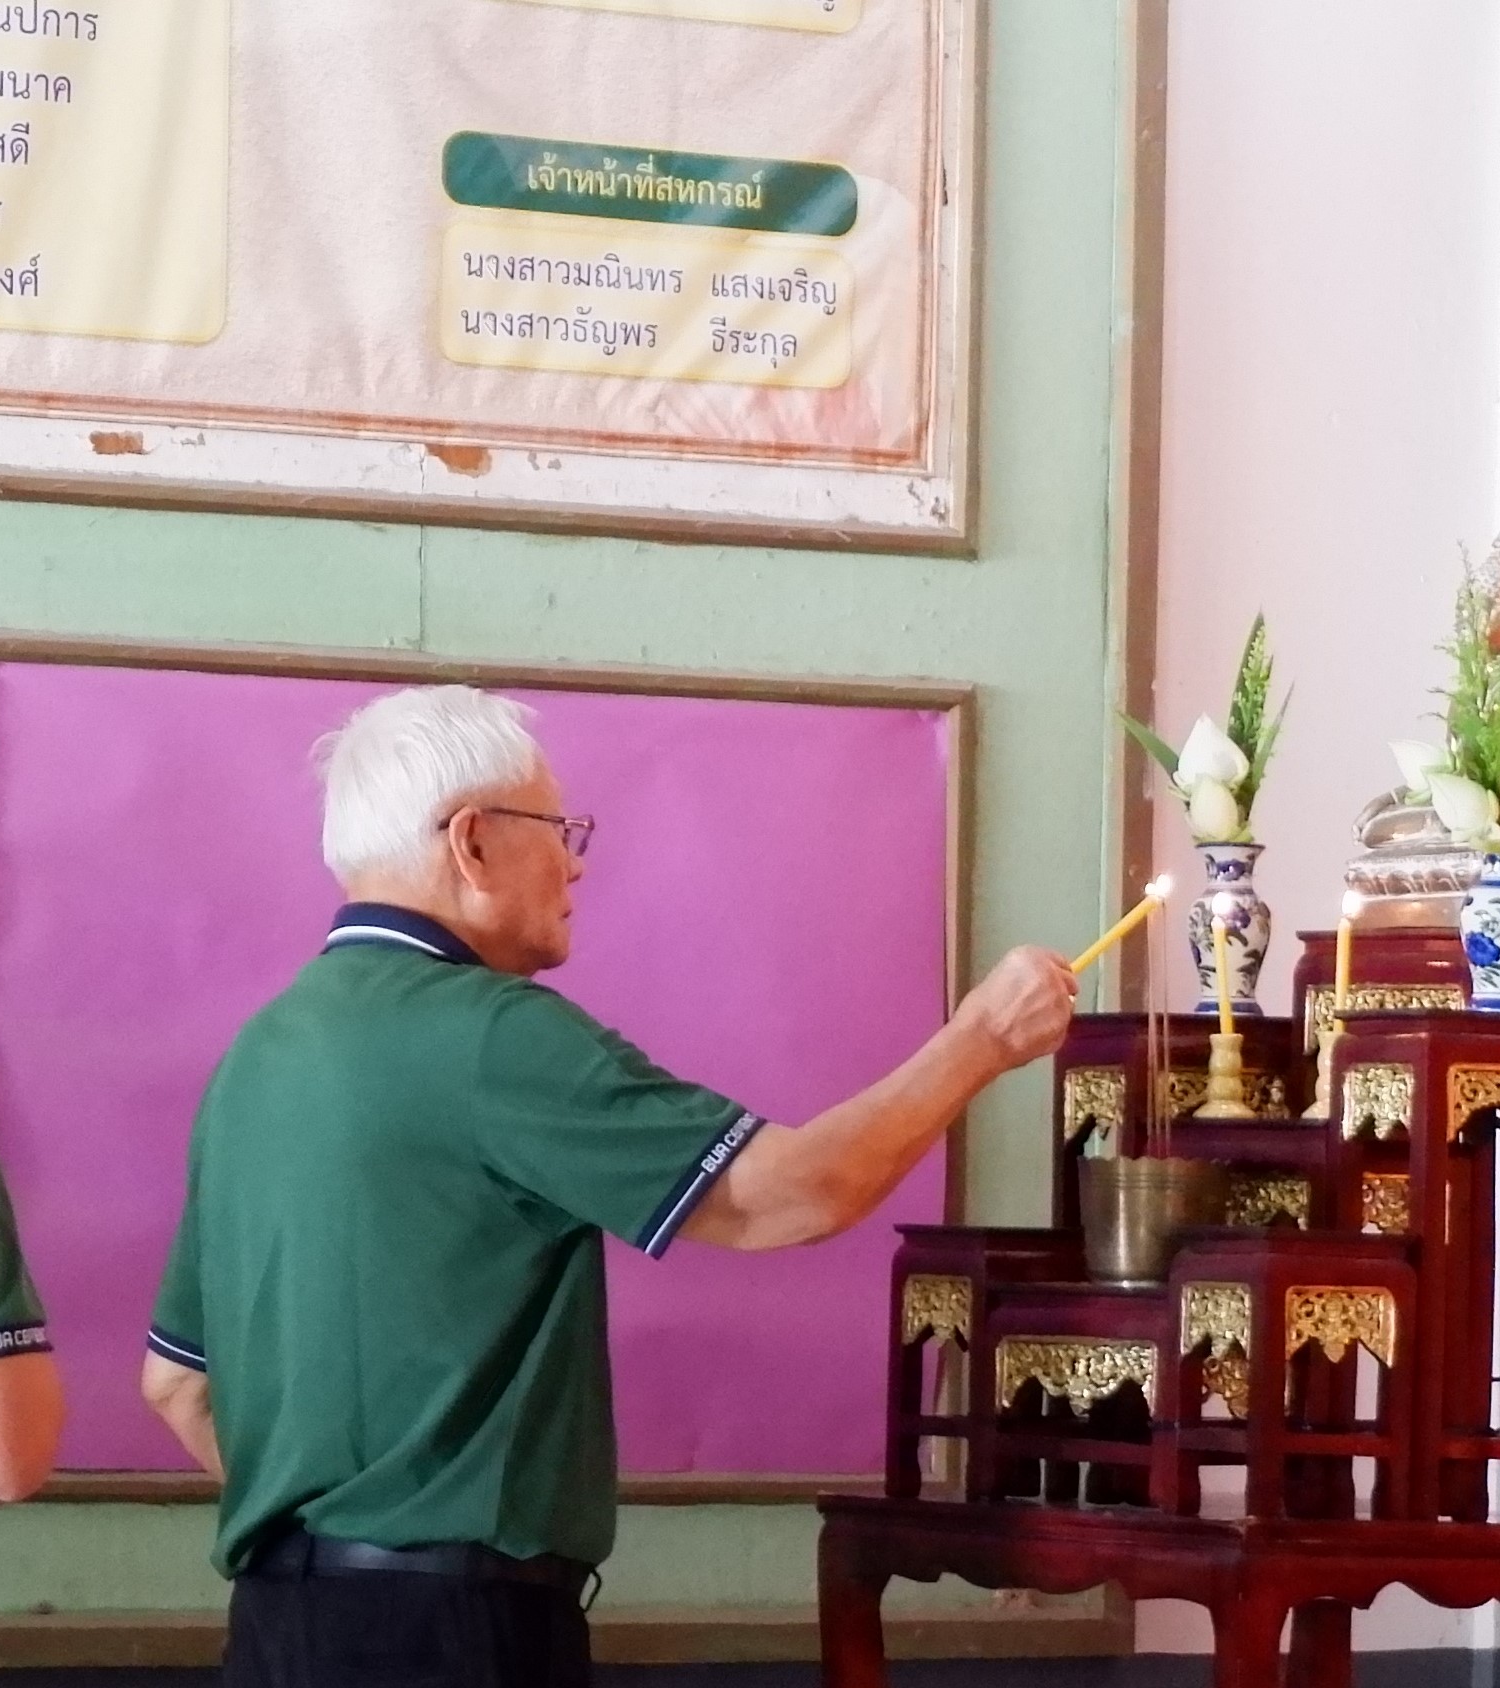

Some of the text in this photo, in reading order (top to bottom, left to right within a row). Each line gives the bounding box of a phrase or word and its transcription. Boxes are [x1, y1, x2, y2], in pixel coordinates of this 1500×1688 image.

[527, 154, 763, 210] เจ้าหน้าที่สหกรณ์
[710, 266, 838, 314] แสงเจริญ
[461, 306, 798, 369] นางสาวธัญพร ธีระกุล
[701, 1143, 730, 1173] BUA
